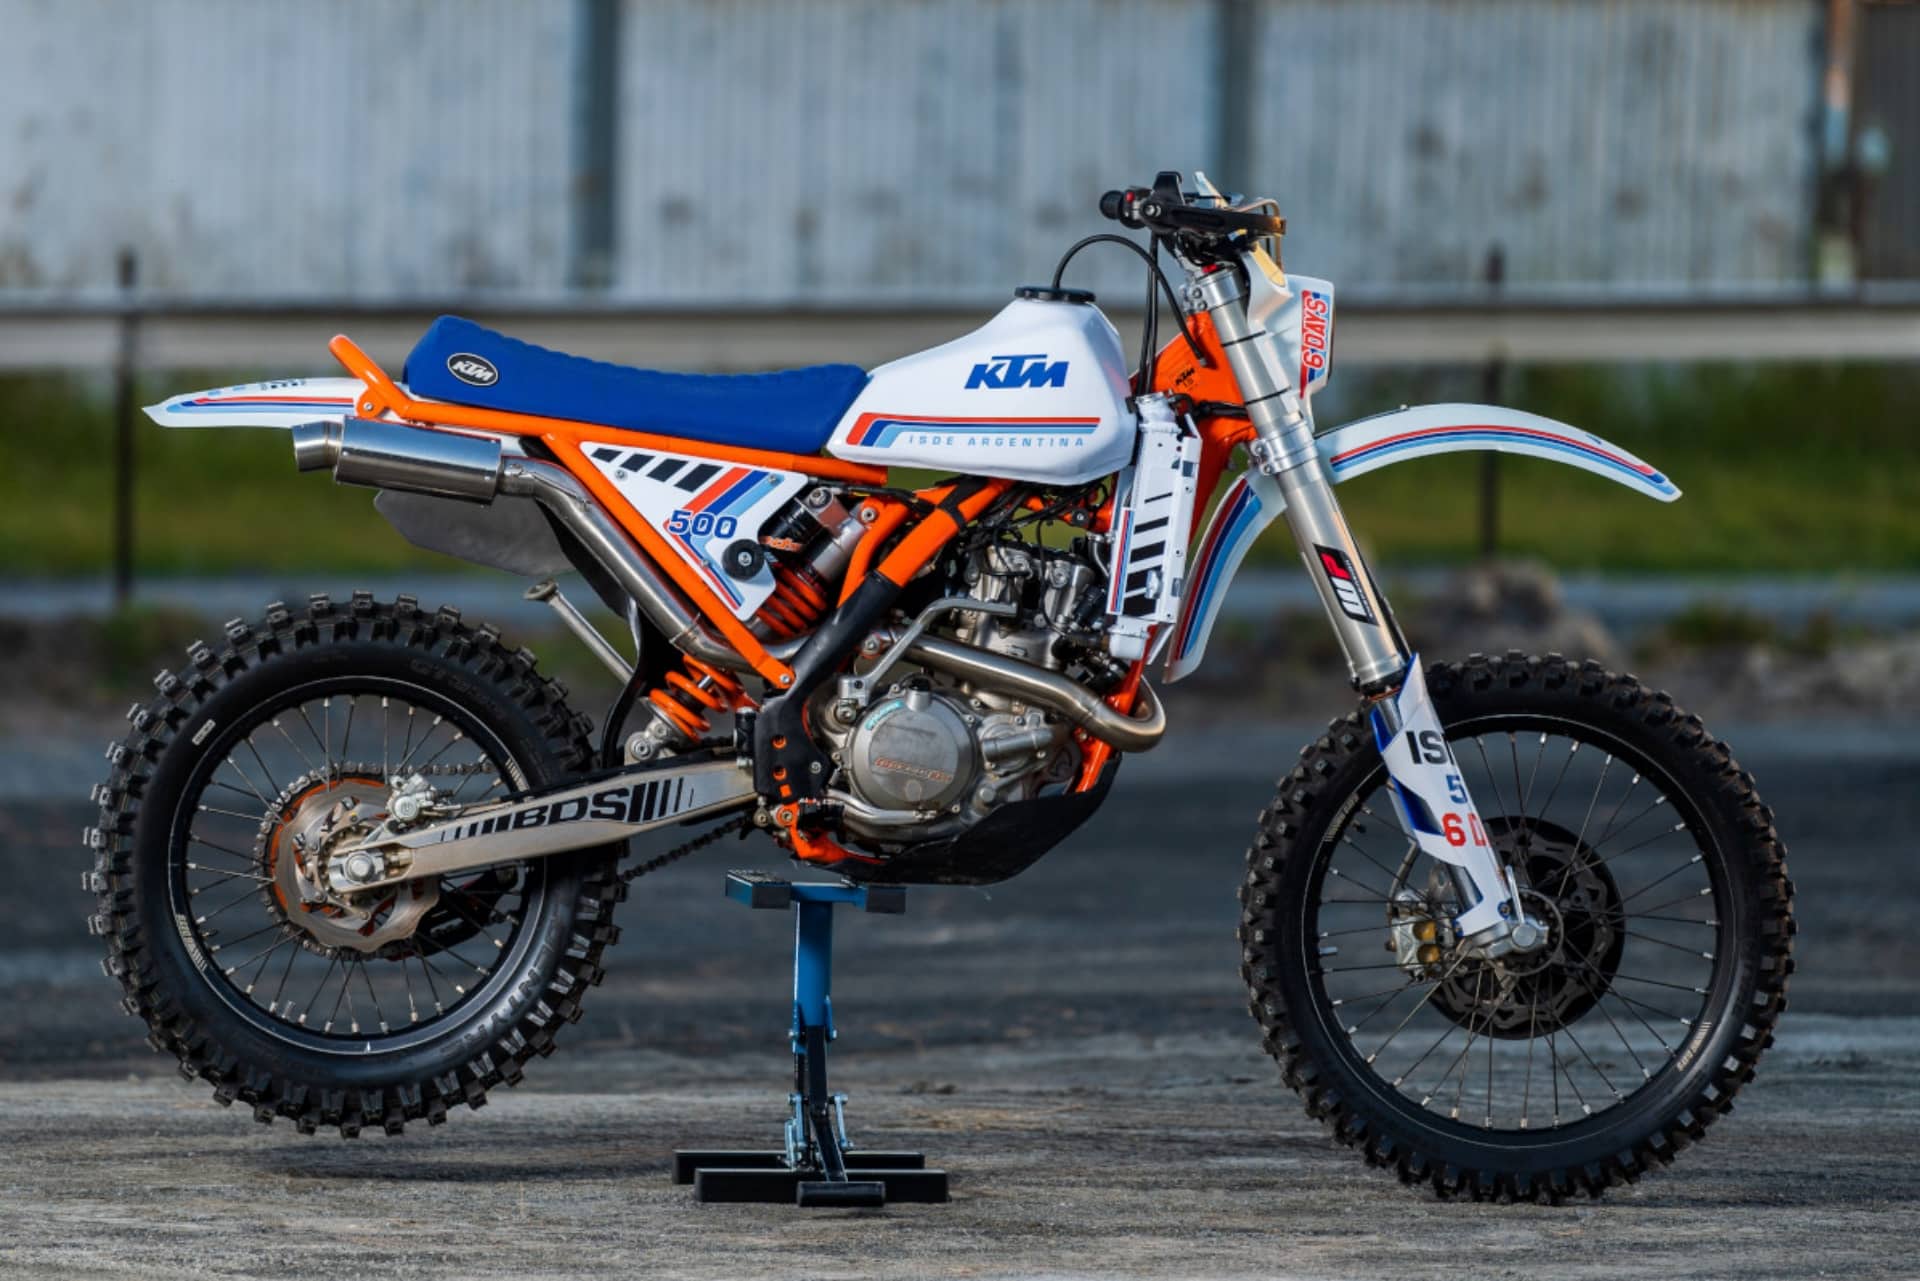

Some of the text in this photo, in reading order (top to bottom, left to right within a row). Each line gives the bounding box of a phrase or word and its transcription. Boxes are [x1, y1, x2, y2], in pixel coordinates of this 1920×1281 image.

[1302, 297, 1328, 369] 6 DAYS
[452, 361, 494, 382] KTM
[964, 353, 1070, 390] KTM
[908, 434, 1085, 448] ISDE ARGENTINA
[668, 510, 738, 540] 500
[1406, 731, 1456, 766] IS
